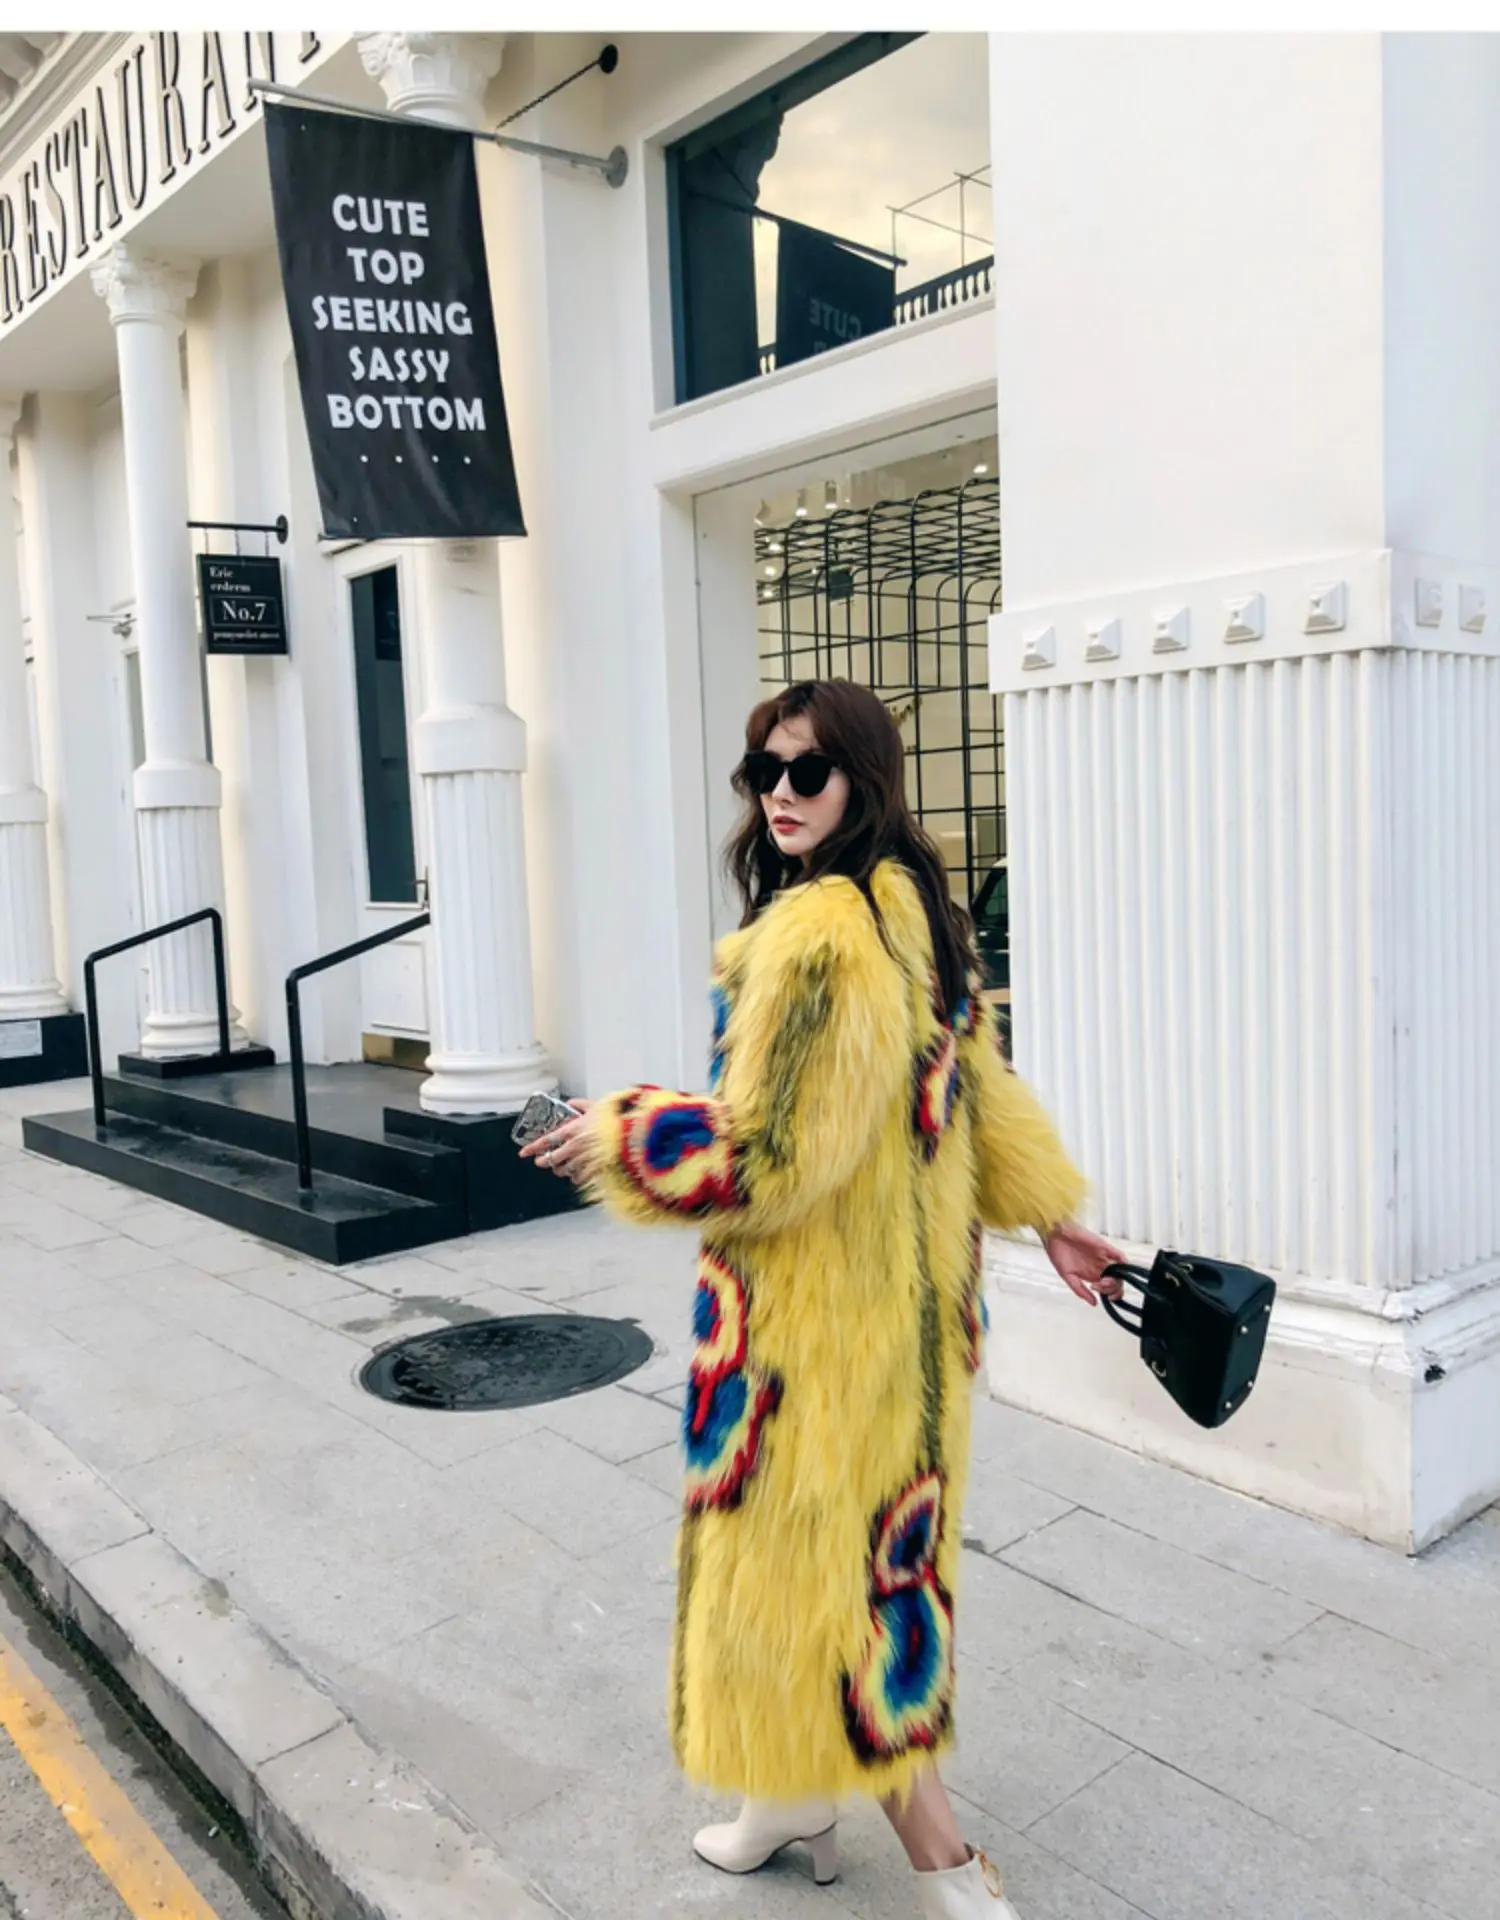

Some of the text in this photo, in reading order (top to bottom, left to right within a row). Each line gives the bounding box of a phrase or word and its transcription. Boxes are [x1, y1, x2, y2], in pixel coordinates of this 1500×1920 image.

[0, 31, 320, 323] RESTAURA
[332, 194, 430, 237] CUTE
[347, 248, 425, 285] TOP
[311, 295, 473, 336] SEEKING
[349, 346, 450, 383] SASSY
[327, 393, 487, 431] BOTTOM
[222, 600, 266, 621] No.7
